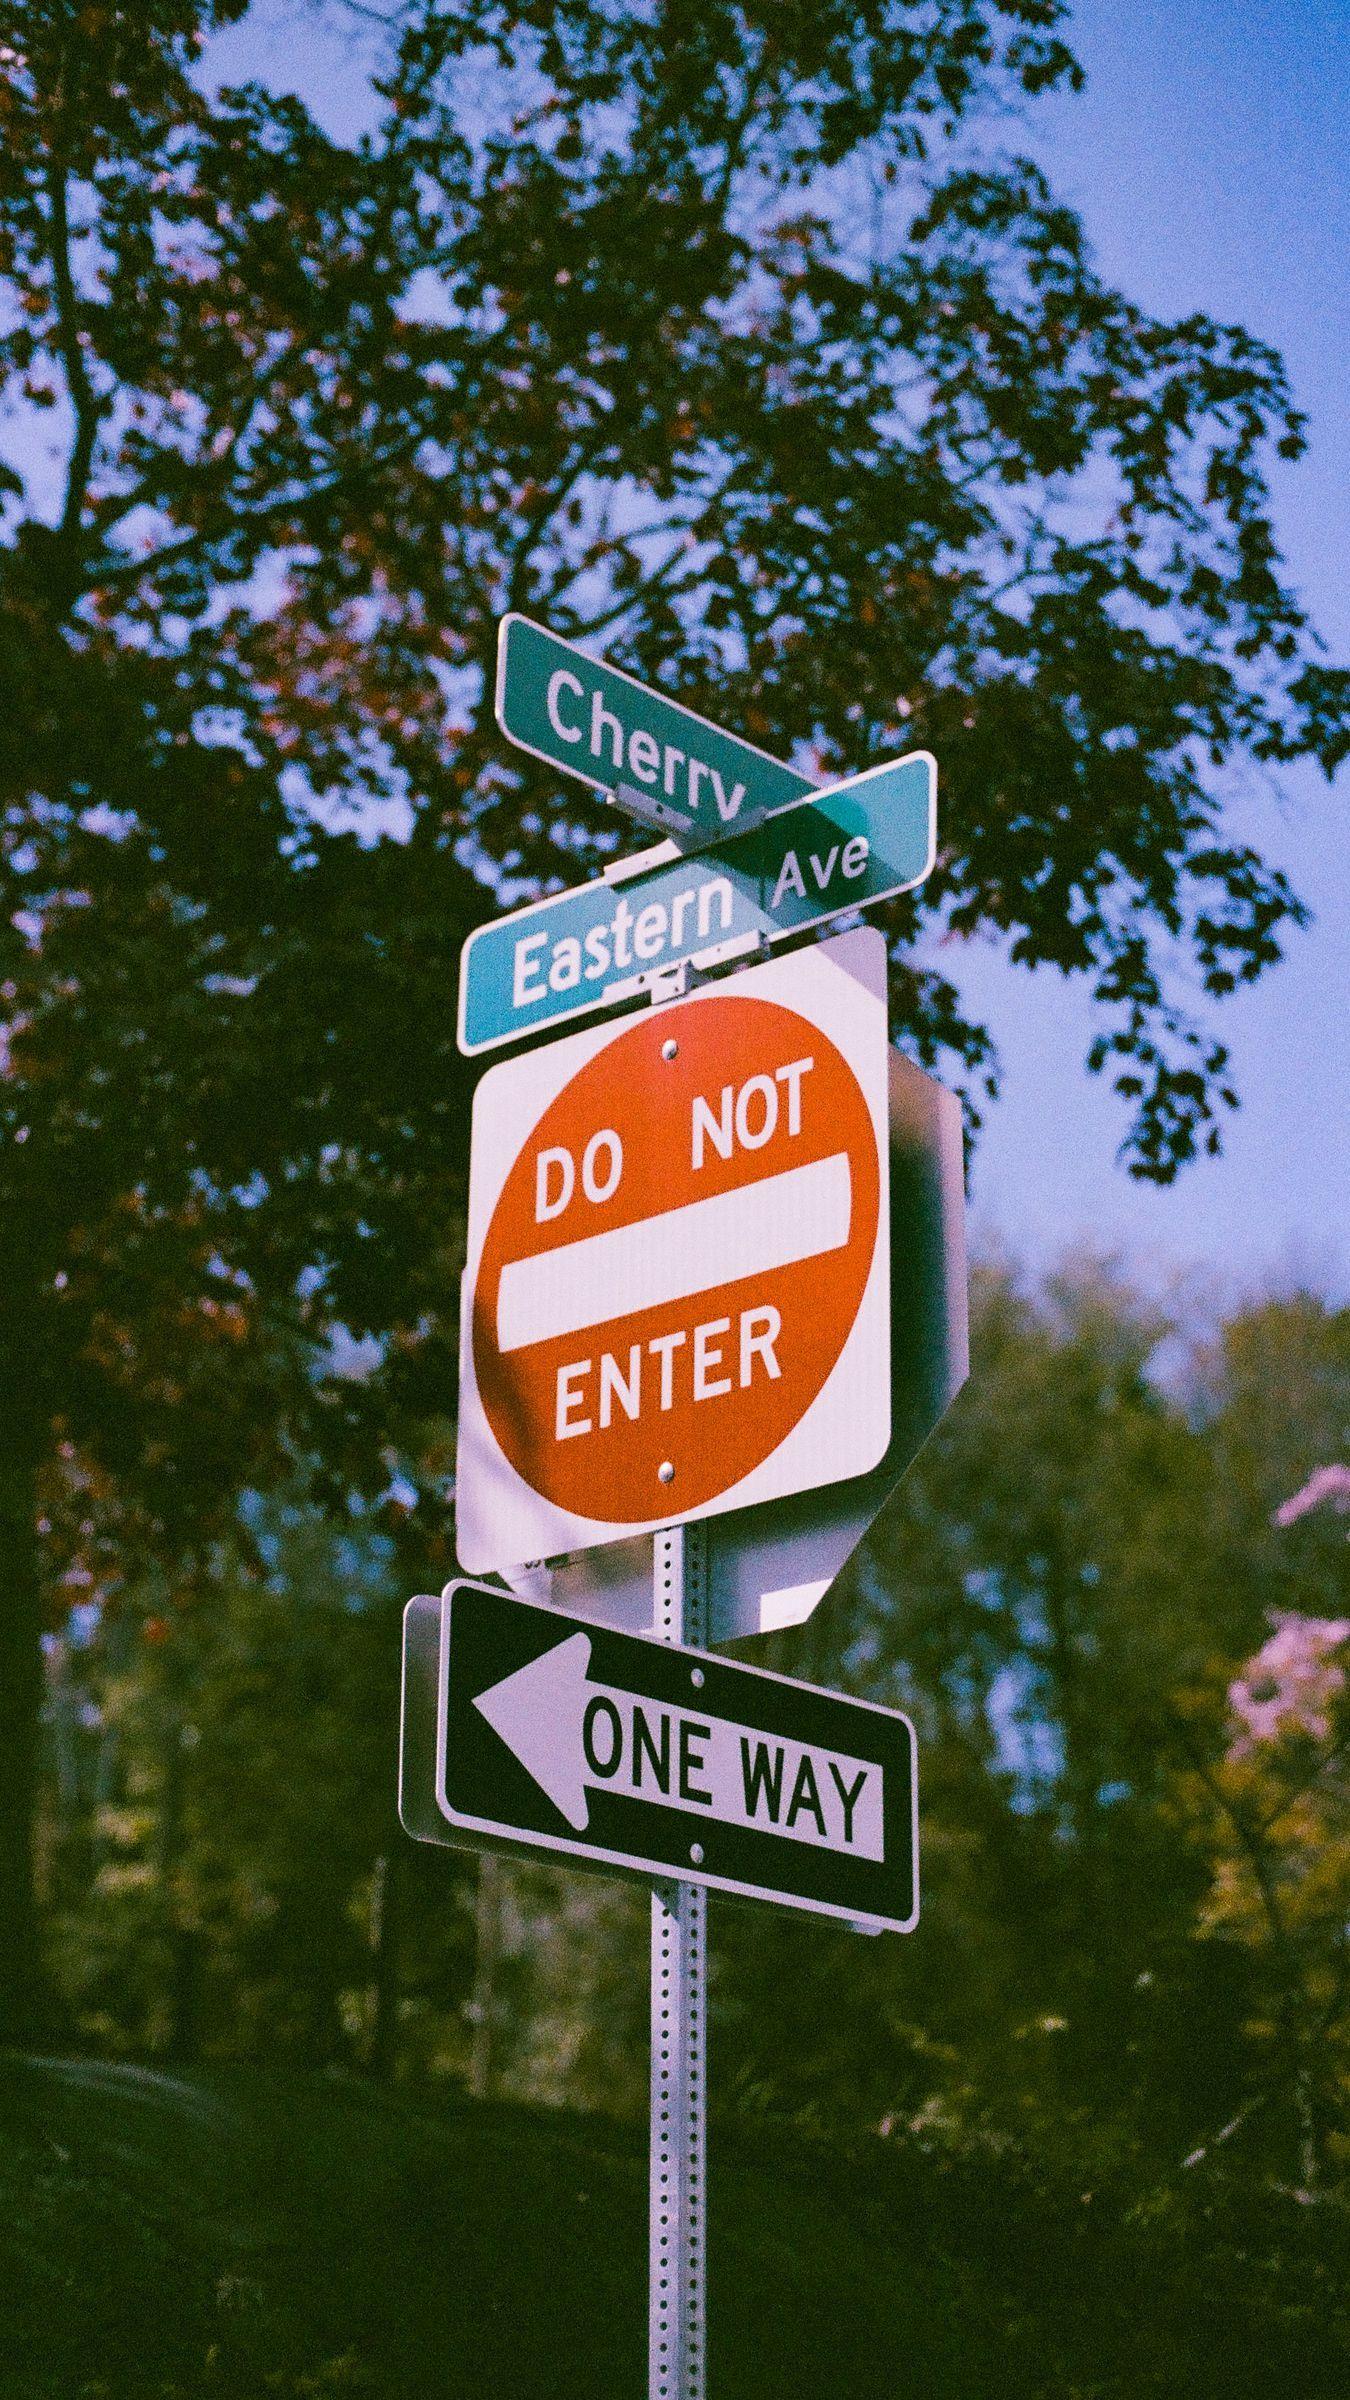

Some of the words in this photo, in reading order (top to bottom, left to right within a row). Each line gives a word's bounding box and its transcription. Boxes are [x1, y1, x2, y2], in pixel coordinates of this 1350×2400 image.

[512, 877, 733, 1008] Eastern
[771, 836, 869, 908] Ave
[535, 1129, 623, 1223] DO
[692, 1057, 814, 1170] NOT
[555, 1305, 782, 1441] ENTER
[583, 1696, 712, 1806] ONE
[740, 1738, 868, 1843] WAY
